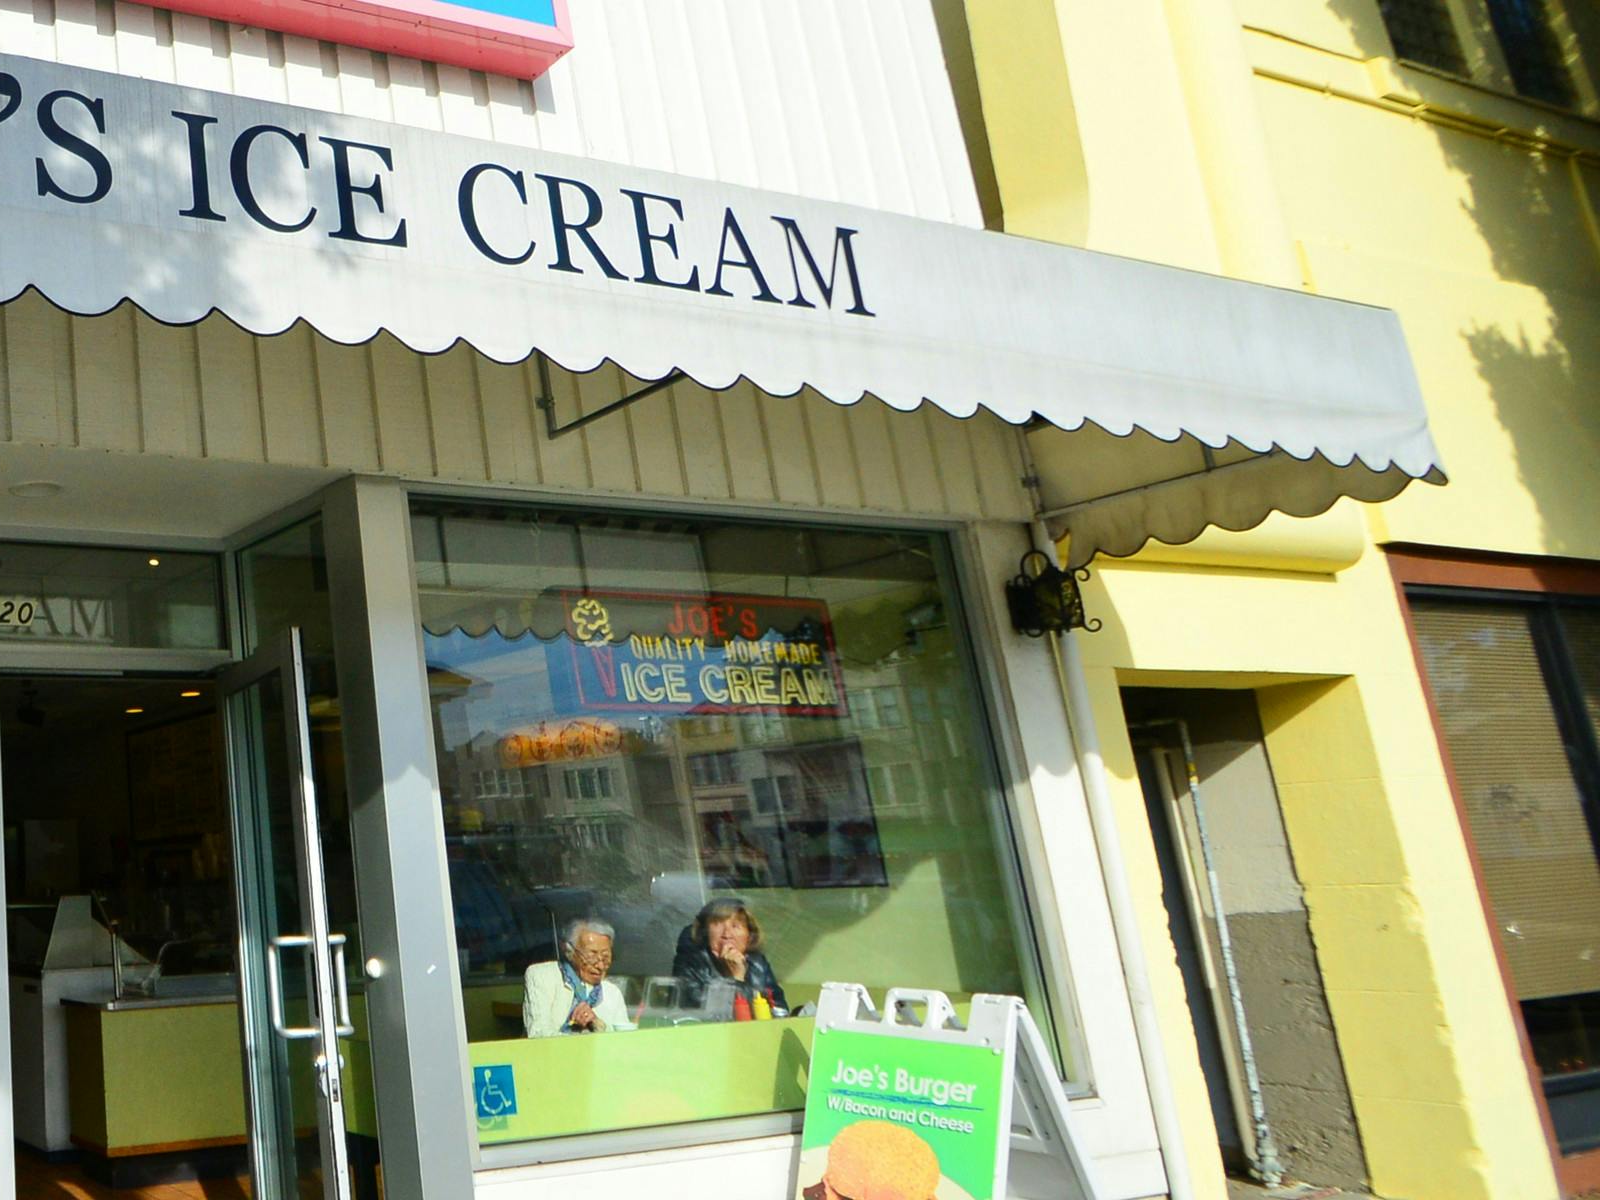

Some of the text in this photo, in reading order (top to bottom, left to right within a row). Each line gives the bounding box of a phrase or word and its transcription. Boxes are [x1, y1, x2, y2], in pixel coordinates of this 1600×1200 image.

[171, 111, 408, 248] ICE
[457, 161, 876, 317] CREAM
[667, 602, 758, 638] JOE'S
[630, 635, 822, 666] QUALITY HOMEMADE
[621, 663, 840, 705] ICE CREAM
[831, 1059, 978, 1105] Joe's Burger
[827, 1095, 975, 1134] W/Bacon and Cheese
